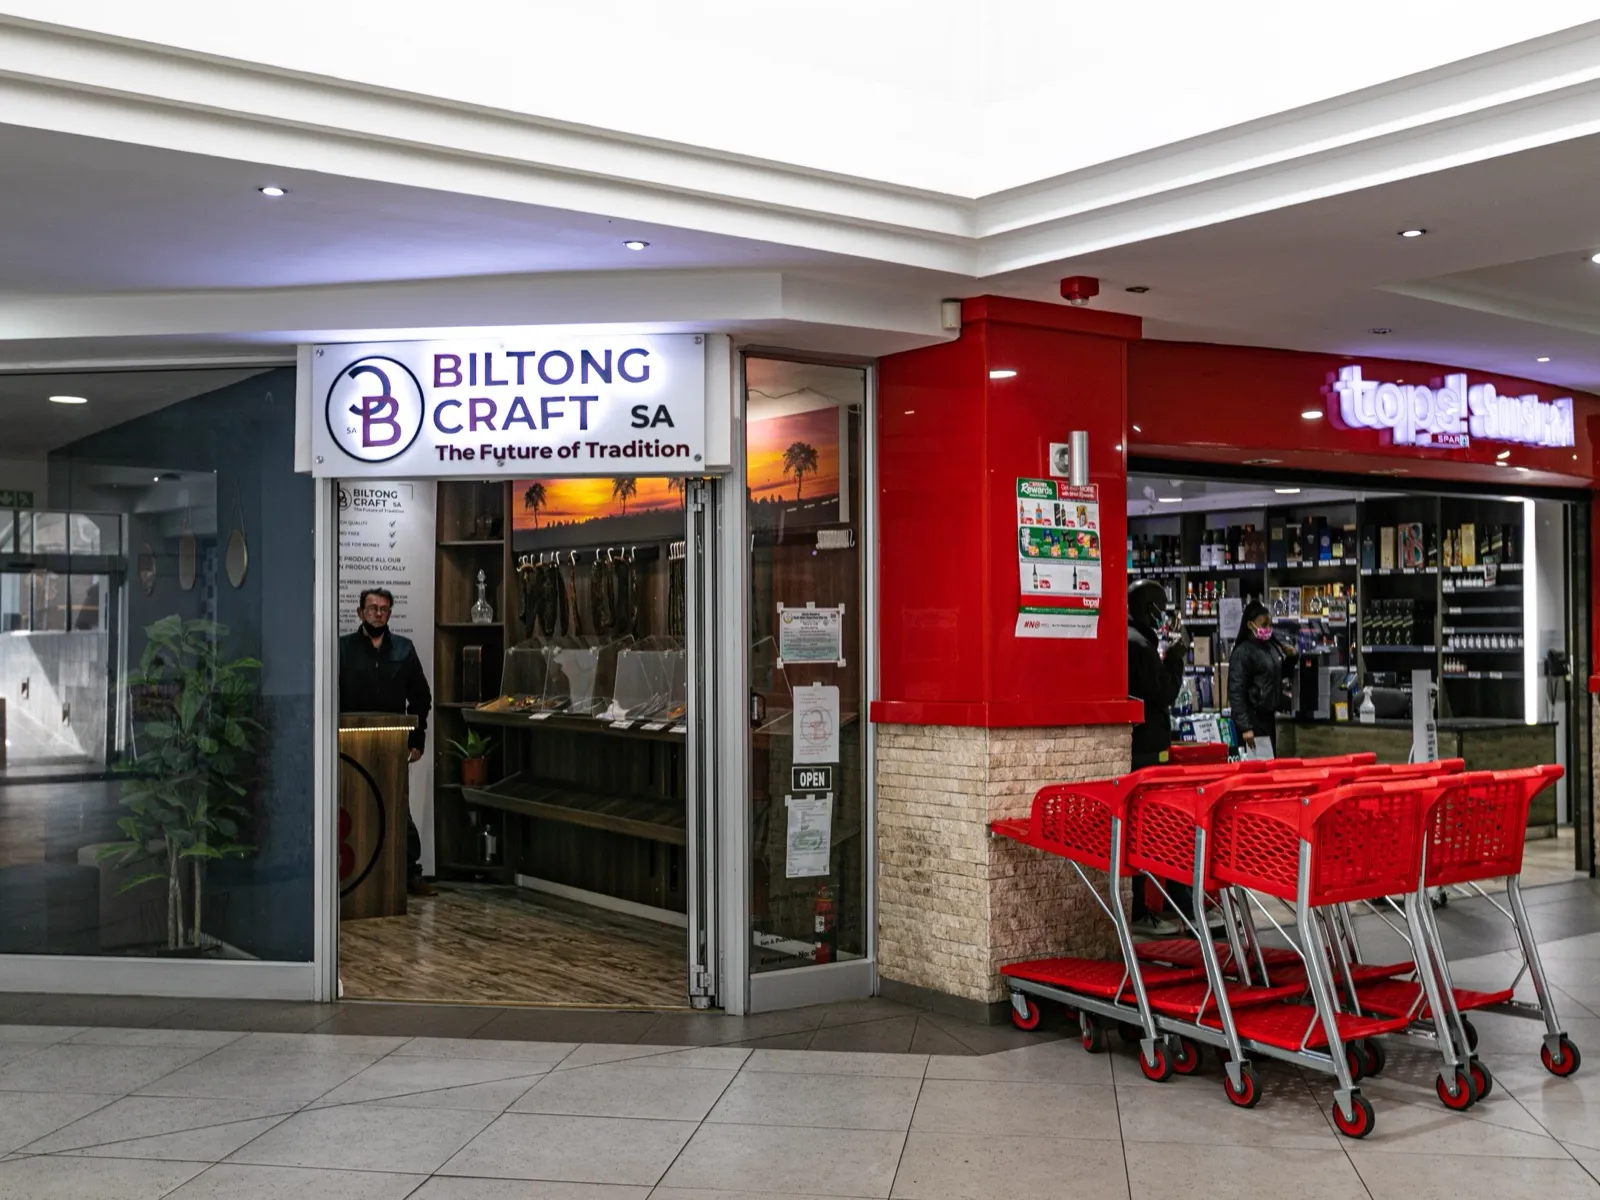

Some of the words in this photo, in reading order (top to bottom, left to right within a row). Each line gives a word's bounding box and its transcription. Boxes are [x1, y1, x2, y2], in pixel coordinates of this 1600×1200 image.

[433, 348, 650, 388] BILTONG
[433, 395, 599, 435] CRAFT
[630, 404, 675, 428] SA
[1438, 435, 1460, 444] SPAR
[435, 444, 475, 461] The
[479, 443, 554, 461] Future
[557, 441, 581, 459] of
[584, 439, 690, 459] Tradition
[353, 489, 398, 499] BILTONG
[1021, 482, 1053, 495] Rewards
[353, 498, 387, 507] CRAFT
[799, 771, 825, 787] OPEN
